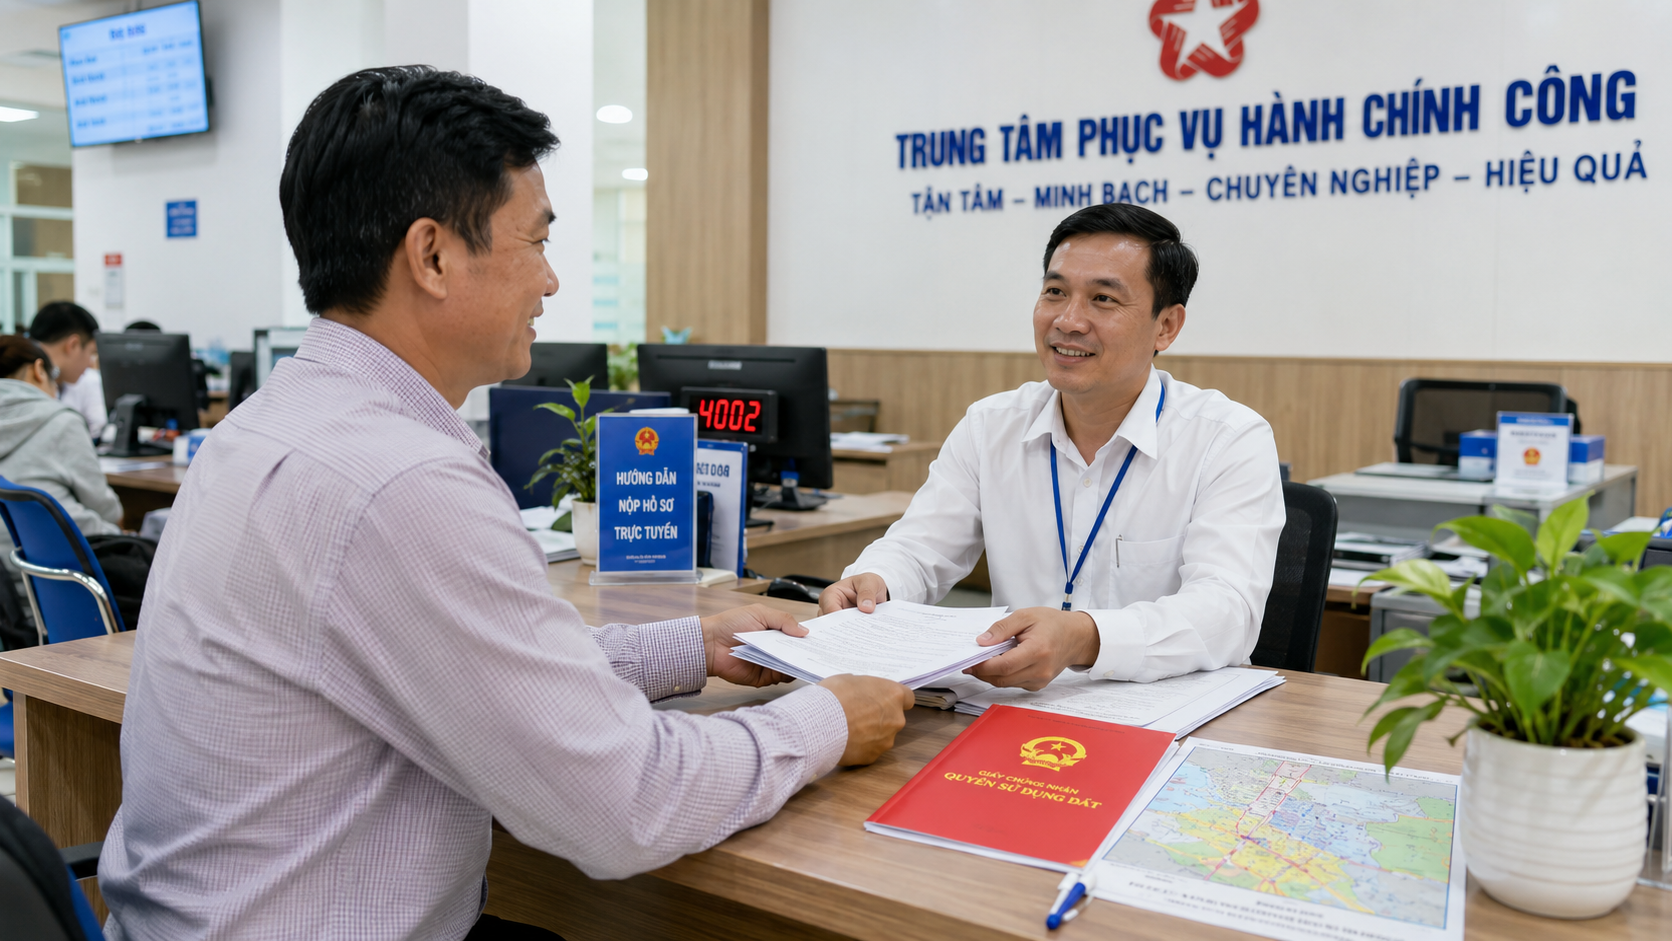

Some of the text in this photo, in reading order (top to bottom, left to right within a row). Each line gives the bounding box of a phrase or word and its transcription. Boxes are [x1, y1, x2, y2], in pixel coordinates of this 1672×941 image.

[896, 64, 1637, 169] TRUNG TÂM PHỤC VỤ HÀNH CHÍNH CÔNG
[960, 183, 1003, 211] TÂM
[1035, 184, 1092, 209] MINH
[1207, 165, 1317, 201] CHUYÊN
[1331, 158, 1440, 199] NGHIỆP
[1486, 150, 1558, 193] HIỆU
[1574, 140, 1647, 184] QUẢ
[699, 399, 761, 432] 4002
[614, 521, 678, 543] TRỰC TUYẾN
